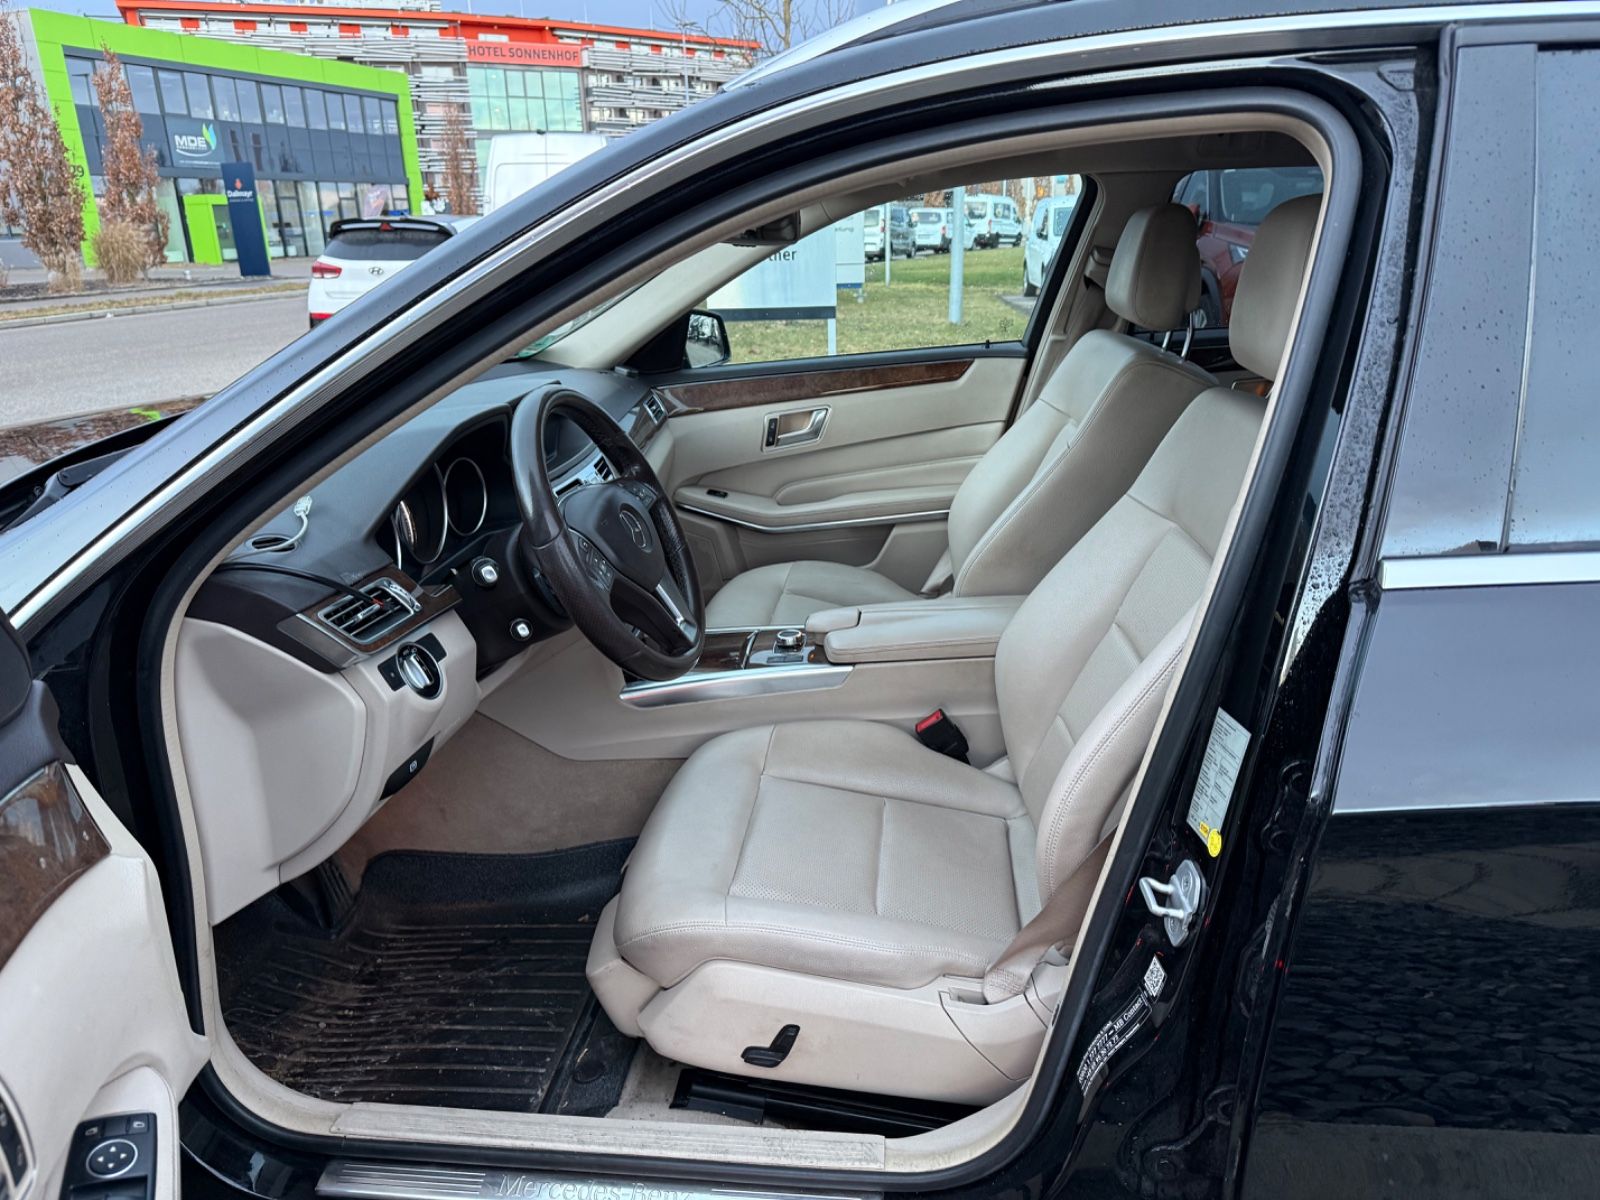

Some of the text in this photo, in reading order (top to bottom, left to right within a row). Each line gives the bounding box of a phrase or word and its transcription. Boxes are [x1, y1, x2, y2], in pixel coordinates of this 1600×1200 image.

[468, 46, 578, 61] HOTEL SONNENHOF
[174, 134, 207, 147] MDE
